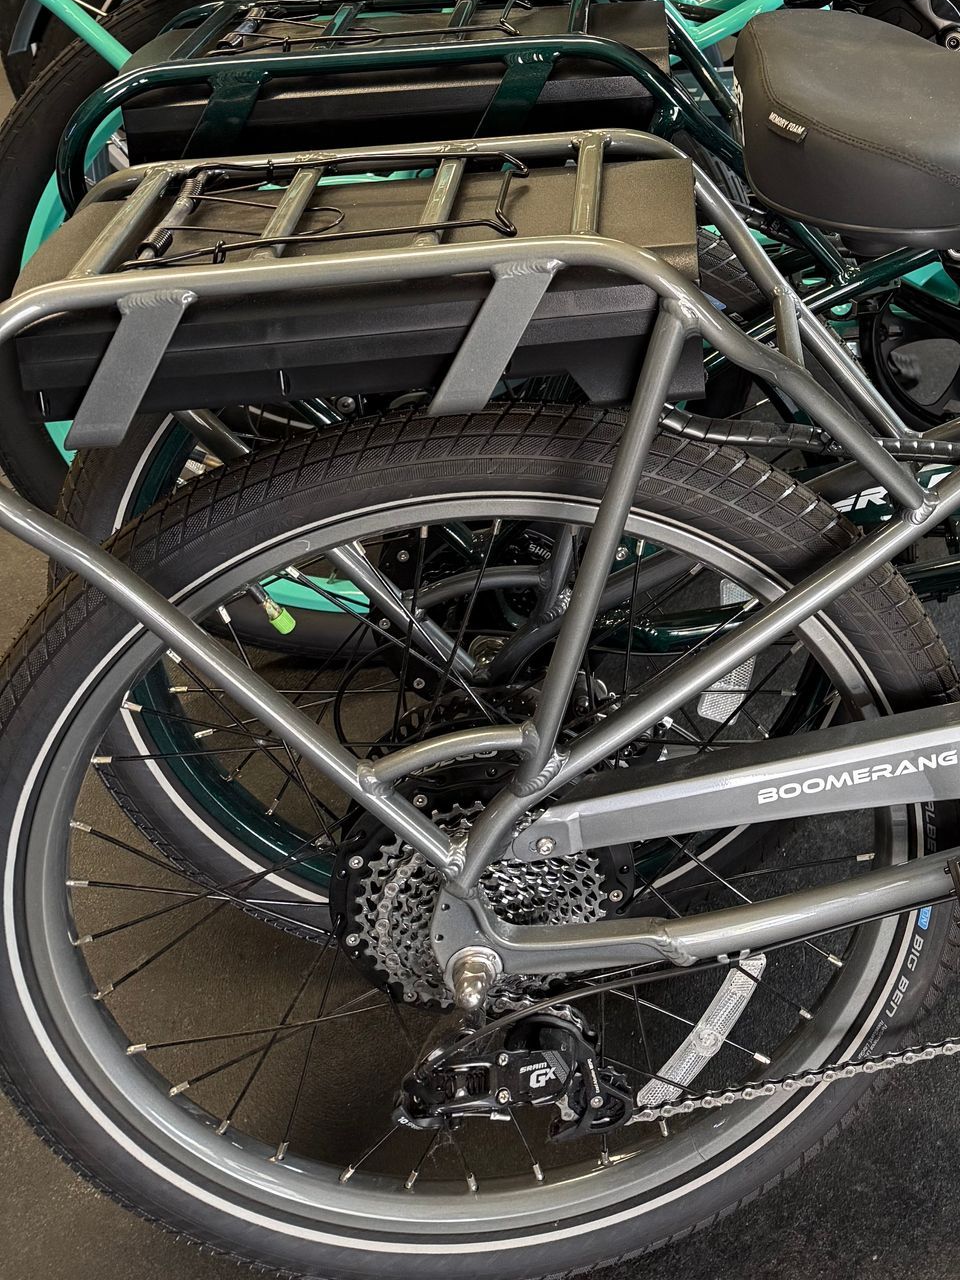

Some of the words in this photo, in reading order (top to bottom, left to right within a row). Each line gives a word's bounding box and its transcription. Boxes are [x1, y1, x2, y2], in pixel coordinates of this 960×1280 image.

[768, 111, 789, 129] MEMORY
[787, 122, 805, 134] FOAM
[757, 750, 958, 805] BOOMERANG
[905, 933, 924, 971] BIG
[885, 976, 910, 1018] BEN
[519, 1062, 548, 1075] SRAM
[529, 1066, 558, 1089] GX
